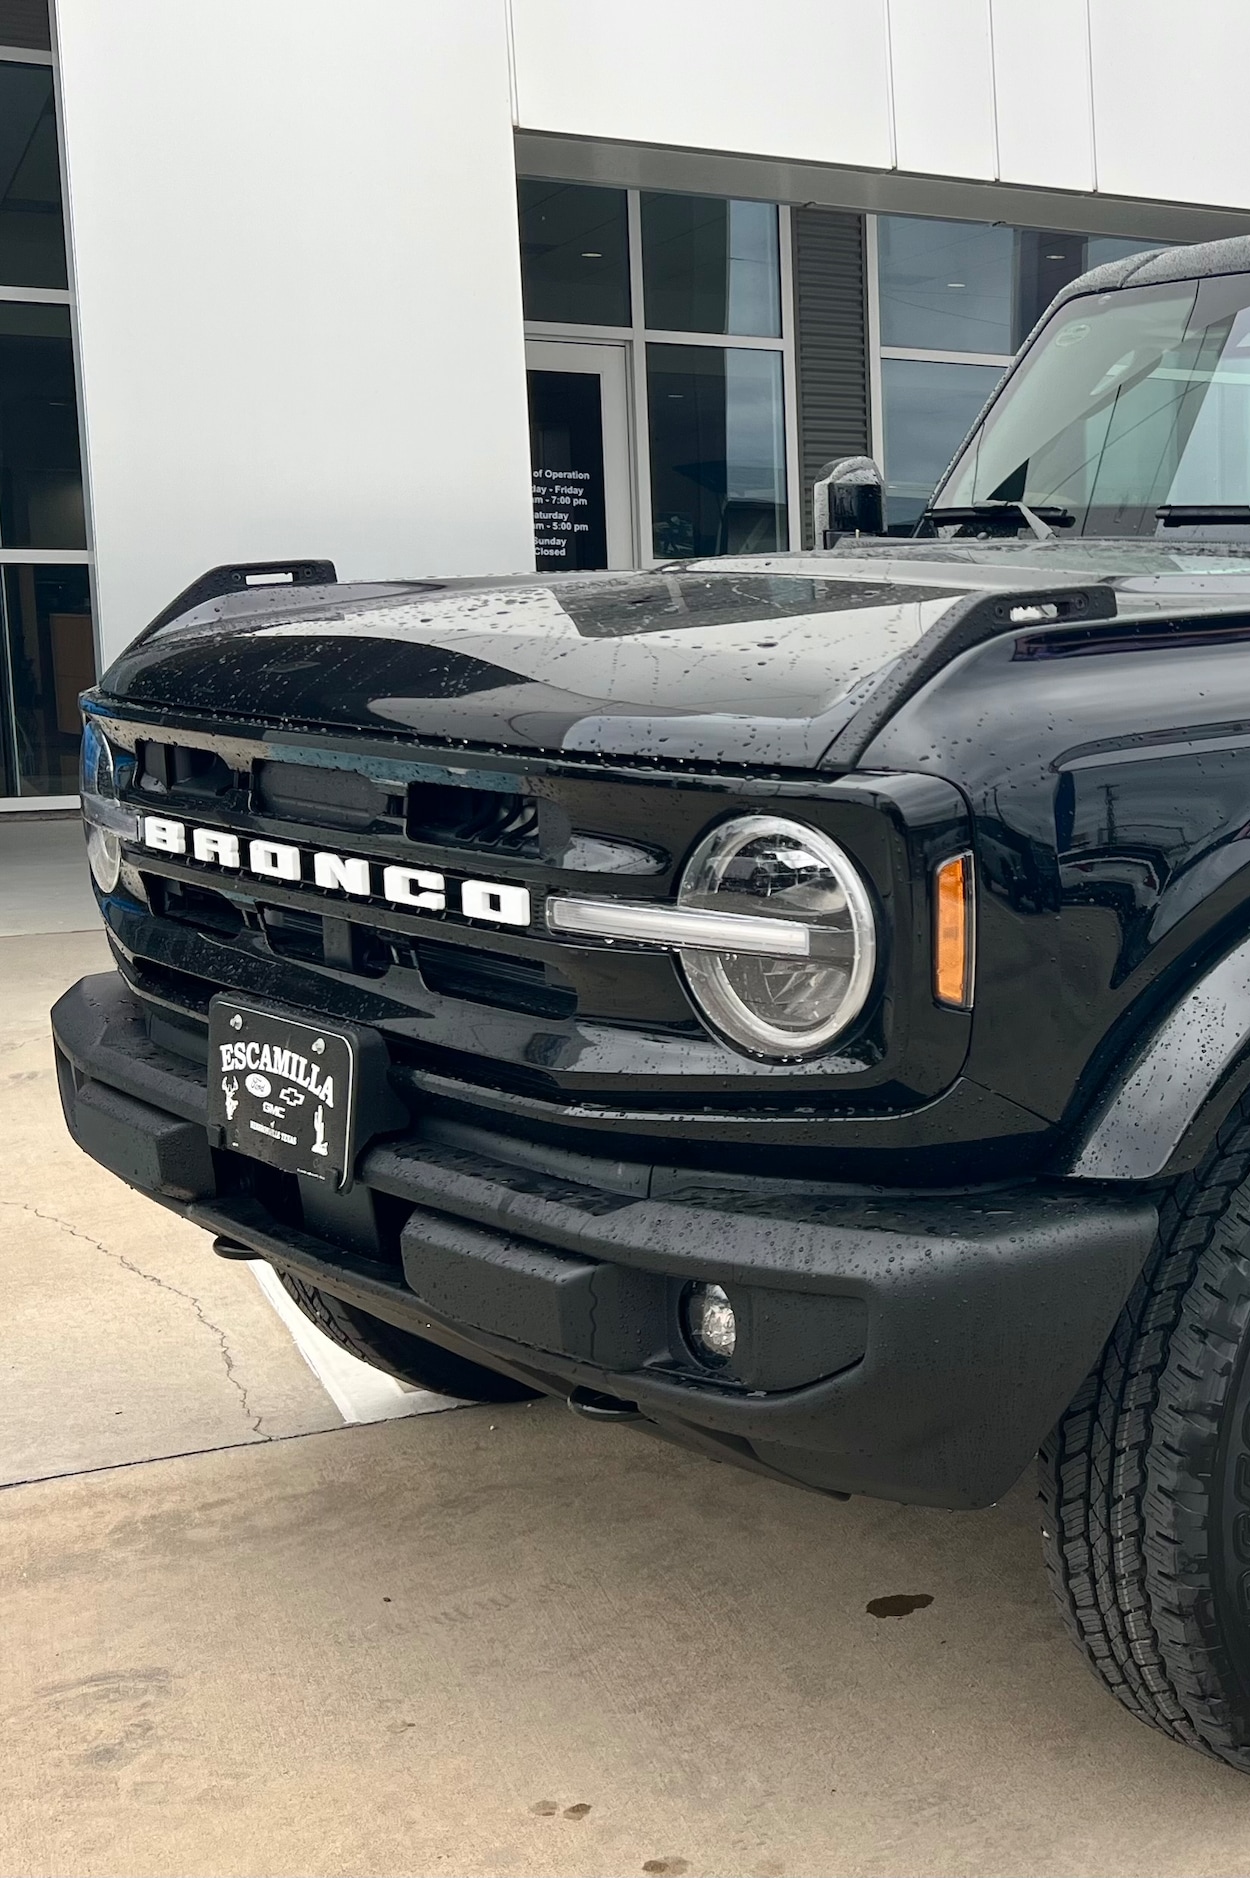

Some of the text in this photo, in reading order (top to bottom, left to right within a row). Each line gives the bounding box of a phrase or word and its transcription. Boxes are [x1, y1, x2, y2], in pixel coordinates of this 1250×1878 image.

[533, 469, 590, 480] of Operation
[555, 485, 584, 496] Friday
[551, 496, 570, 505] 7:00
[573, 498, 587, 506] pm
[552, 522, 571, 531] 5:00
[574, 524, 588, 532] pm
[535, 547, 566, 556] Closed
[144, 815, 531, 927] BRONCO
[219, 1041, 334, 1109] ESCAMILLA
[262, 1101, 286, 1119] GMC
